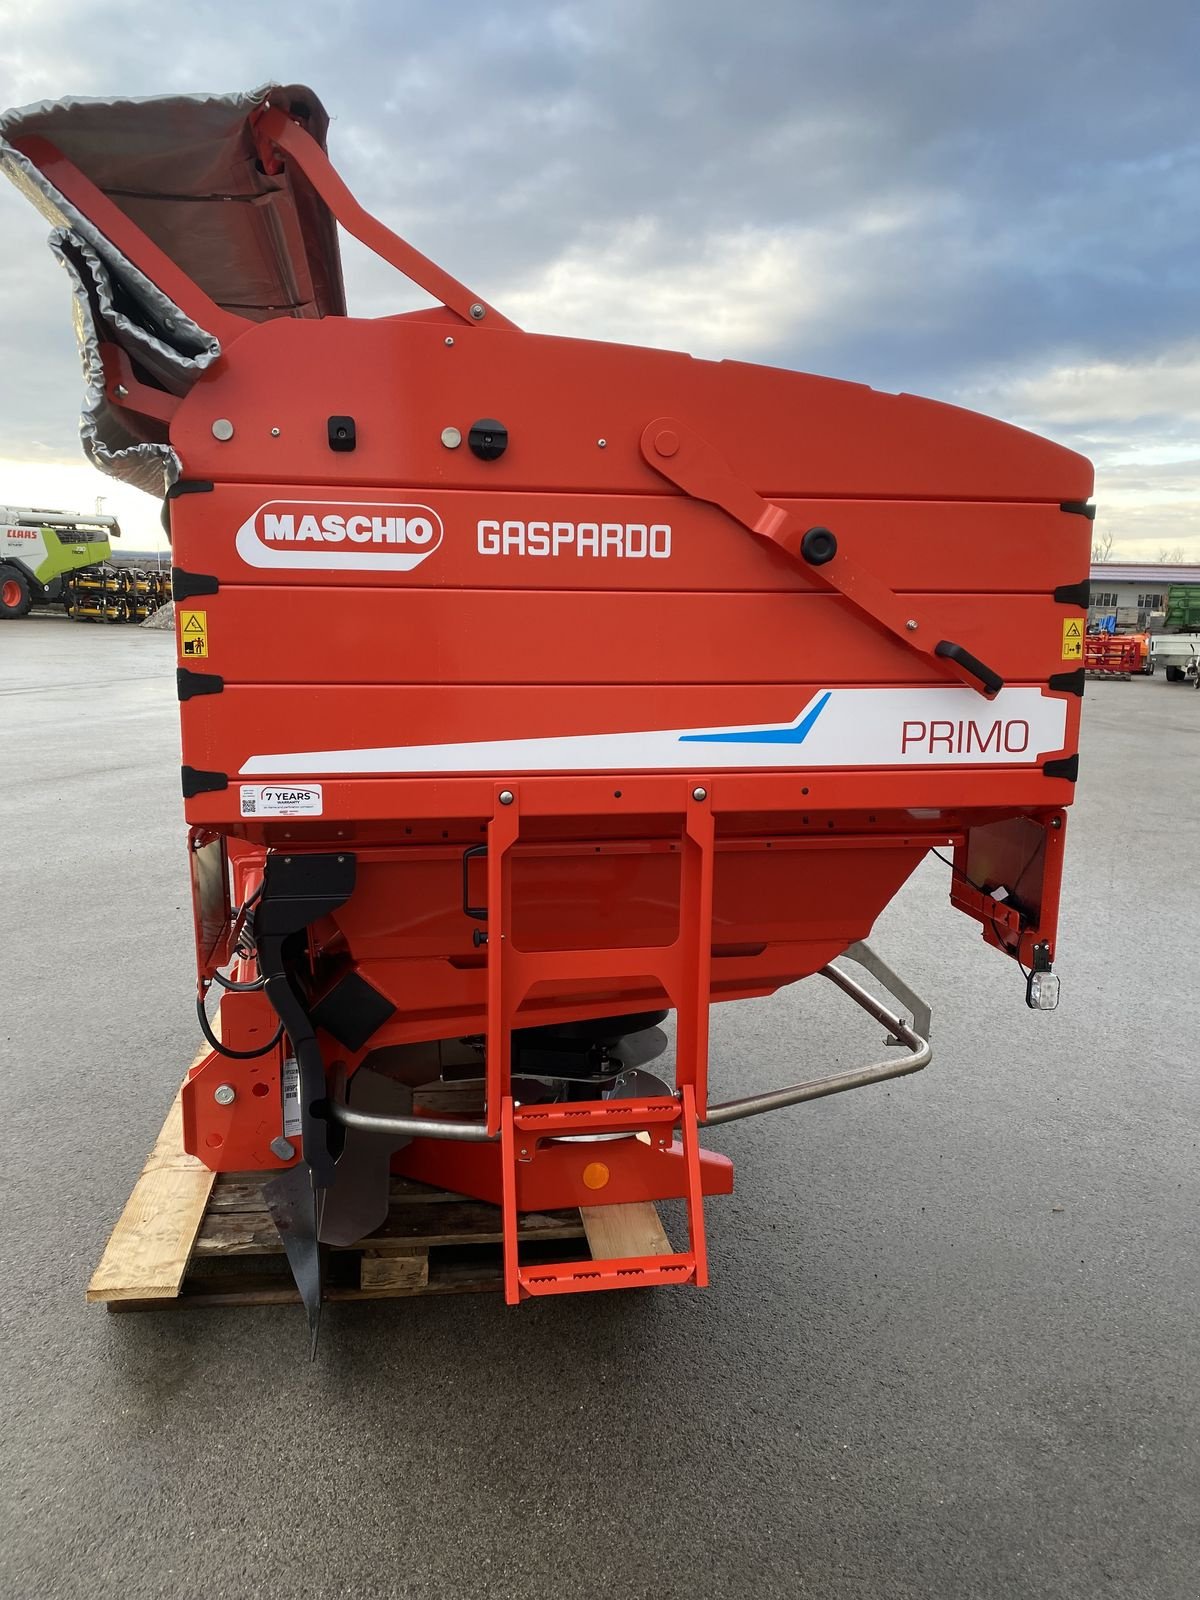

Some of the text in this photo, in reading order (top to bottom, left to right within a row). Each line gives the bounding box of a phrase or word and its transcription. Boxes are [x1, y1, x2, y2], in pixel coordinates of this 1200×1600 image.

[7, 529, 37, 539] CLAAS
[264, 514, 433, 544] MASCHIO
[477, 520, 671, 558] GASPARDO
[901, 720, 1029, 754] PRIMO
